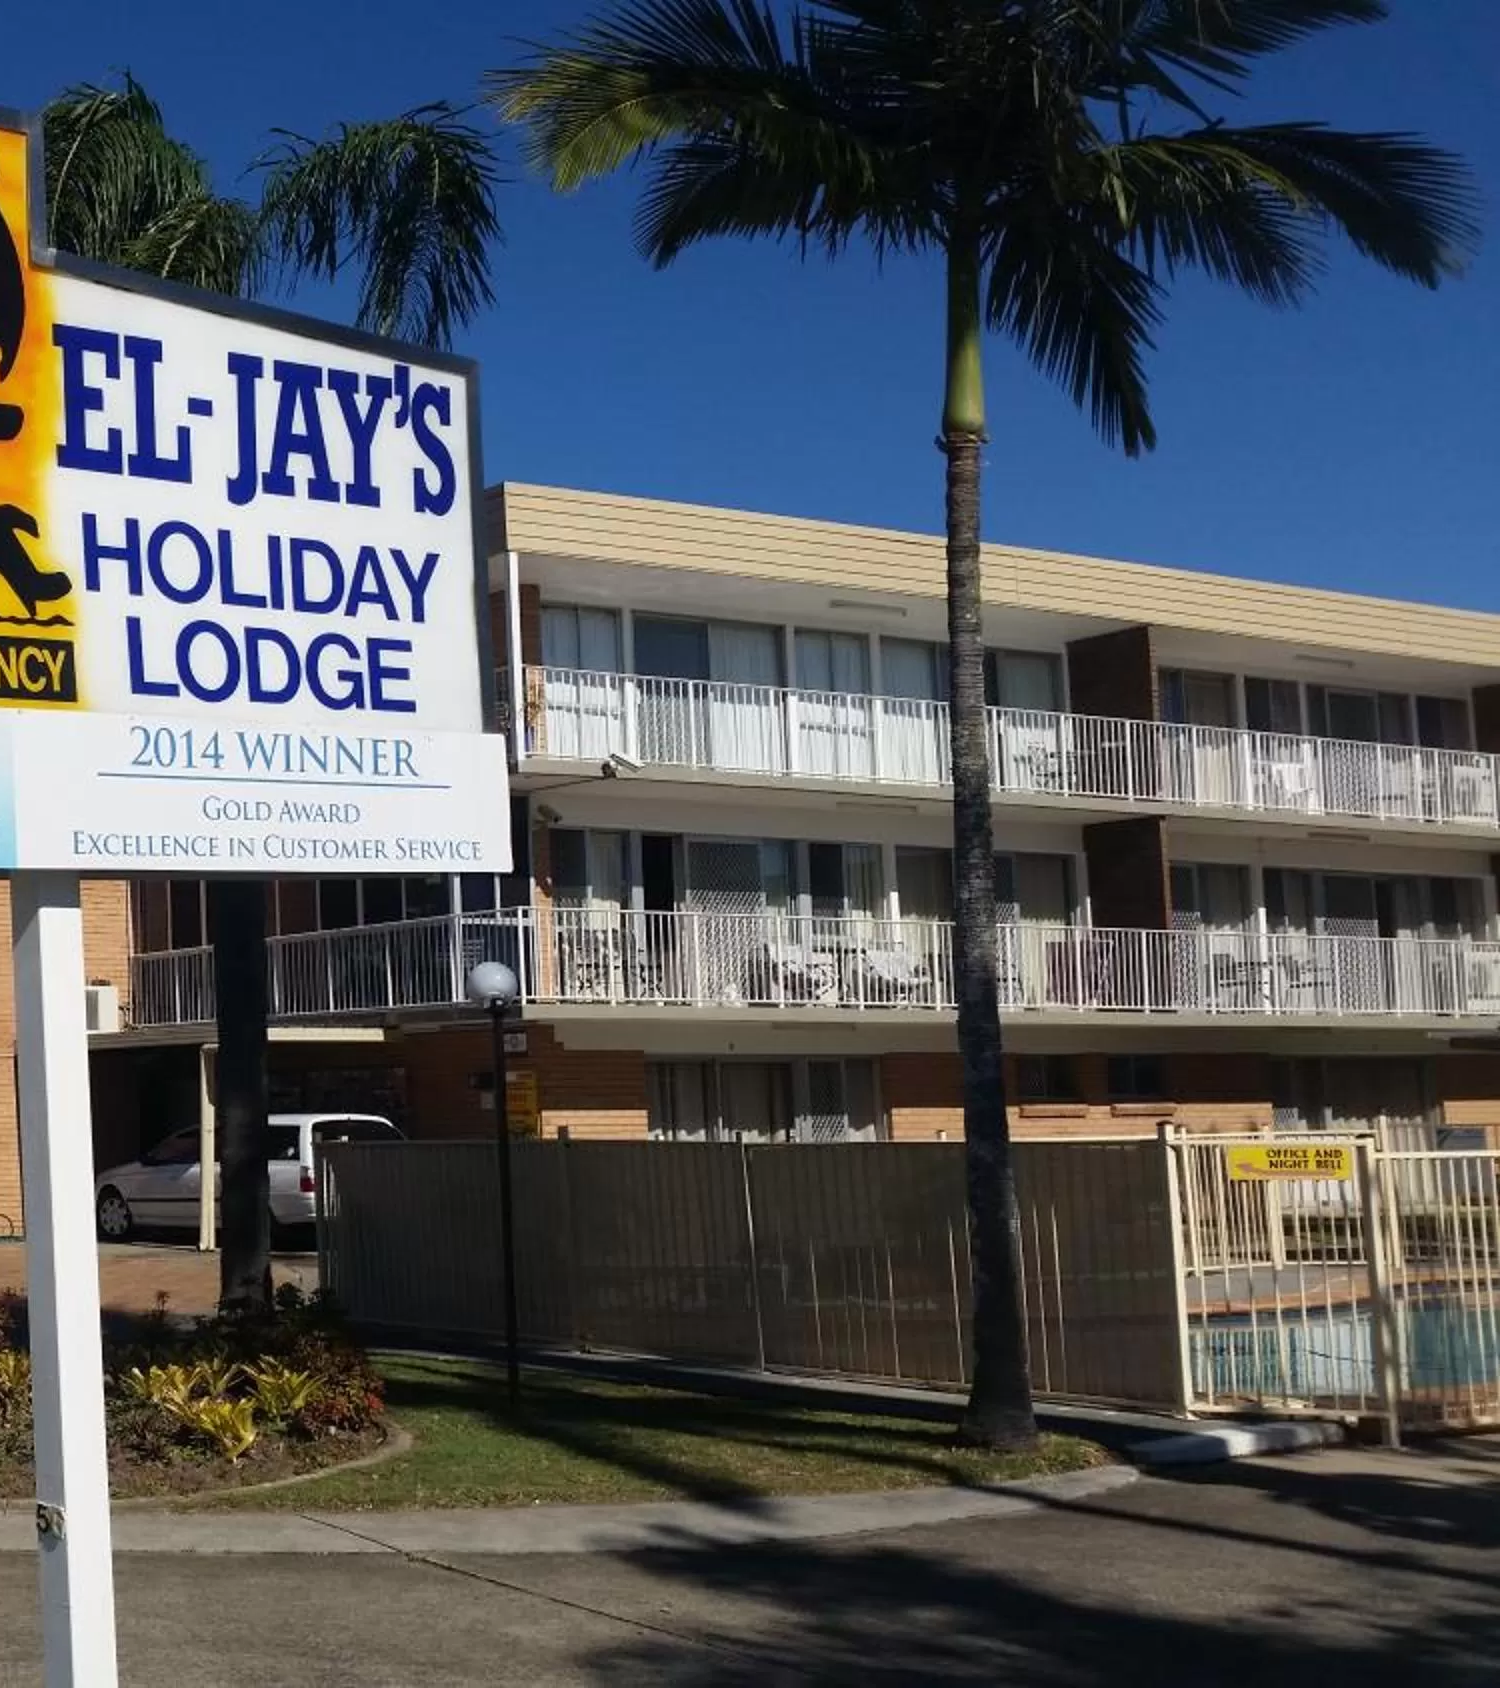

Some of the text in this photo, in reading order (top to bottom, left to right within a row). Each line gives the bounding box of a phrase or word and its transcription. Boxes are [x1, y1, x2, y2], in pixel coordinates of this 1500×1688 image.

[53, 323, 457, 517] EL-JAY'S
[82, 511, 440, 624] HOLIDAY
[126, 615, 417, 713] LODGE
[130, 725, 420, 778] 2014 WINNER
[202, 795, 361, 825] GOLD AWARD
[72, 829, 482, 861] EXCELLENCE IN CUSTOMER SERVICE
[1314, 1148, 1343, 1159] AND
